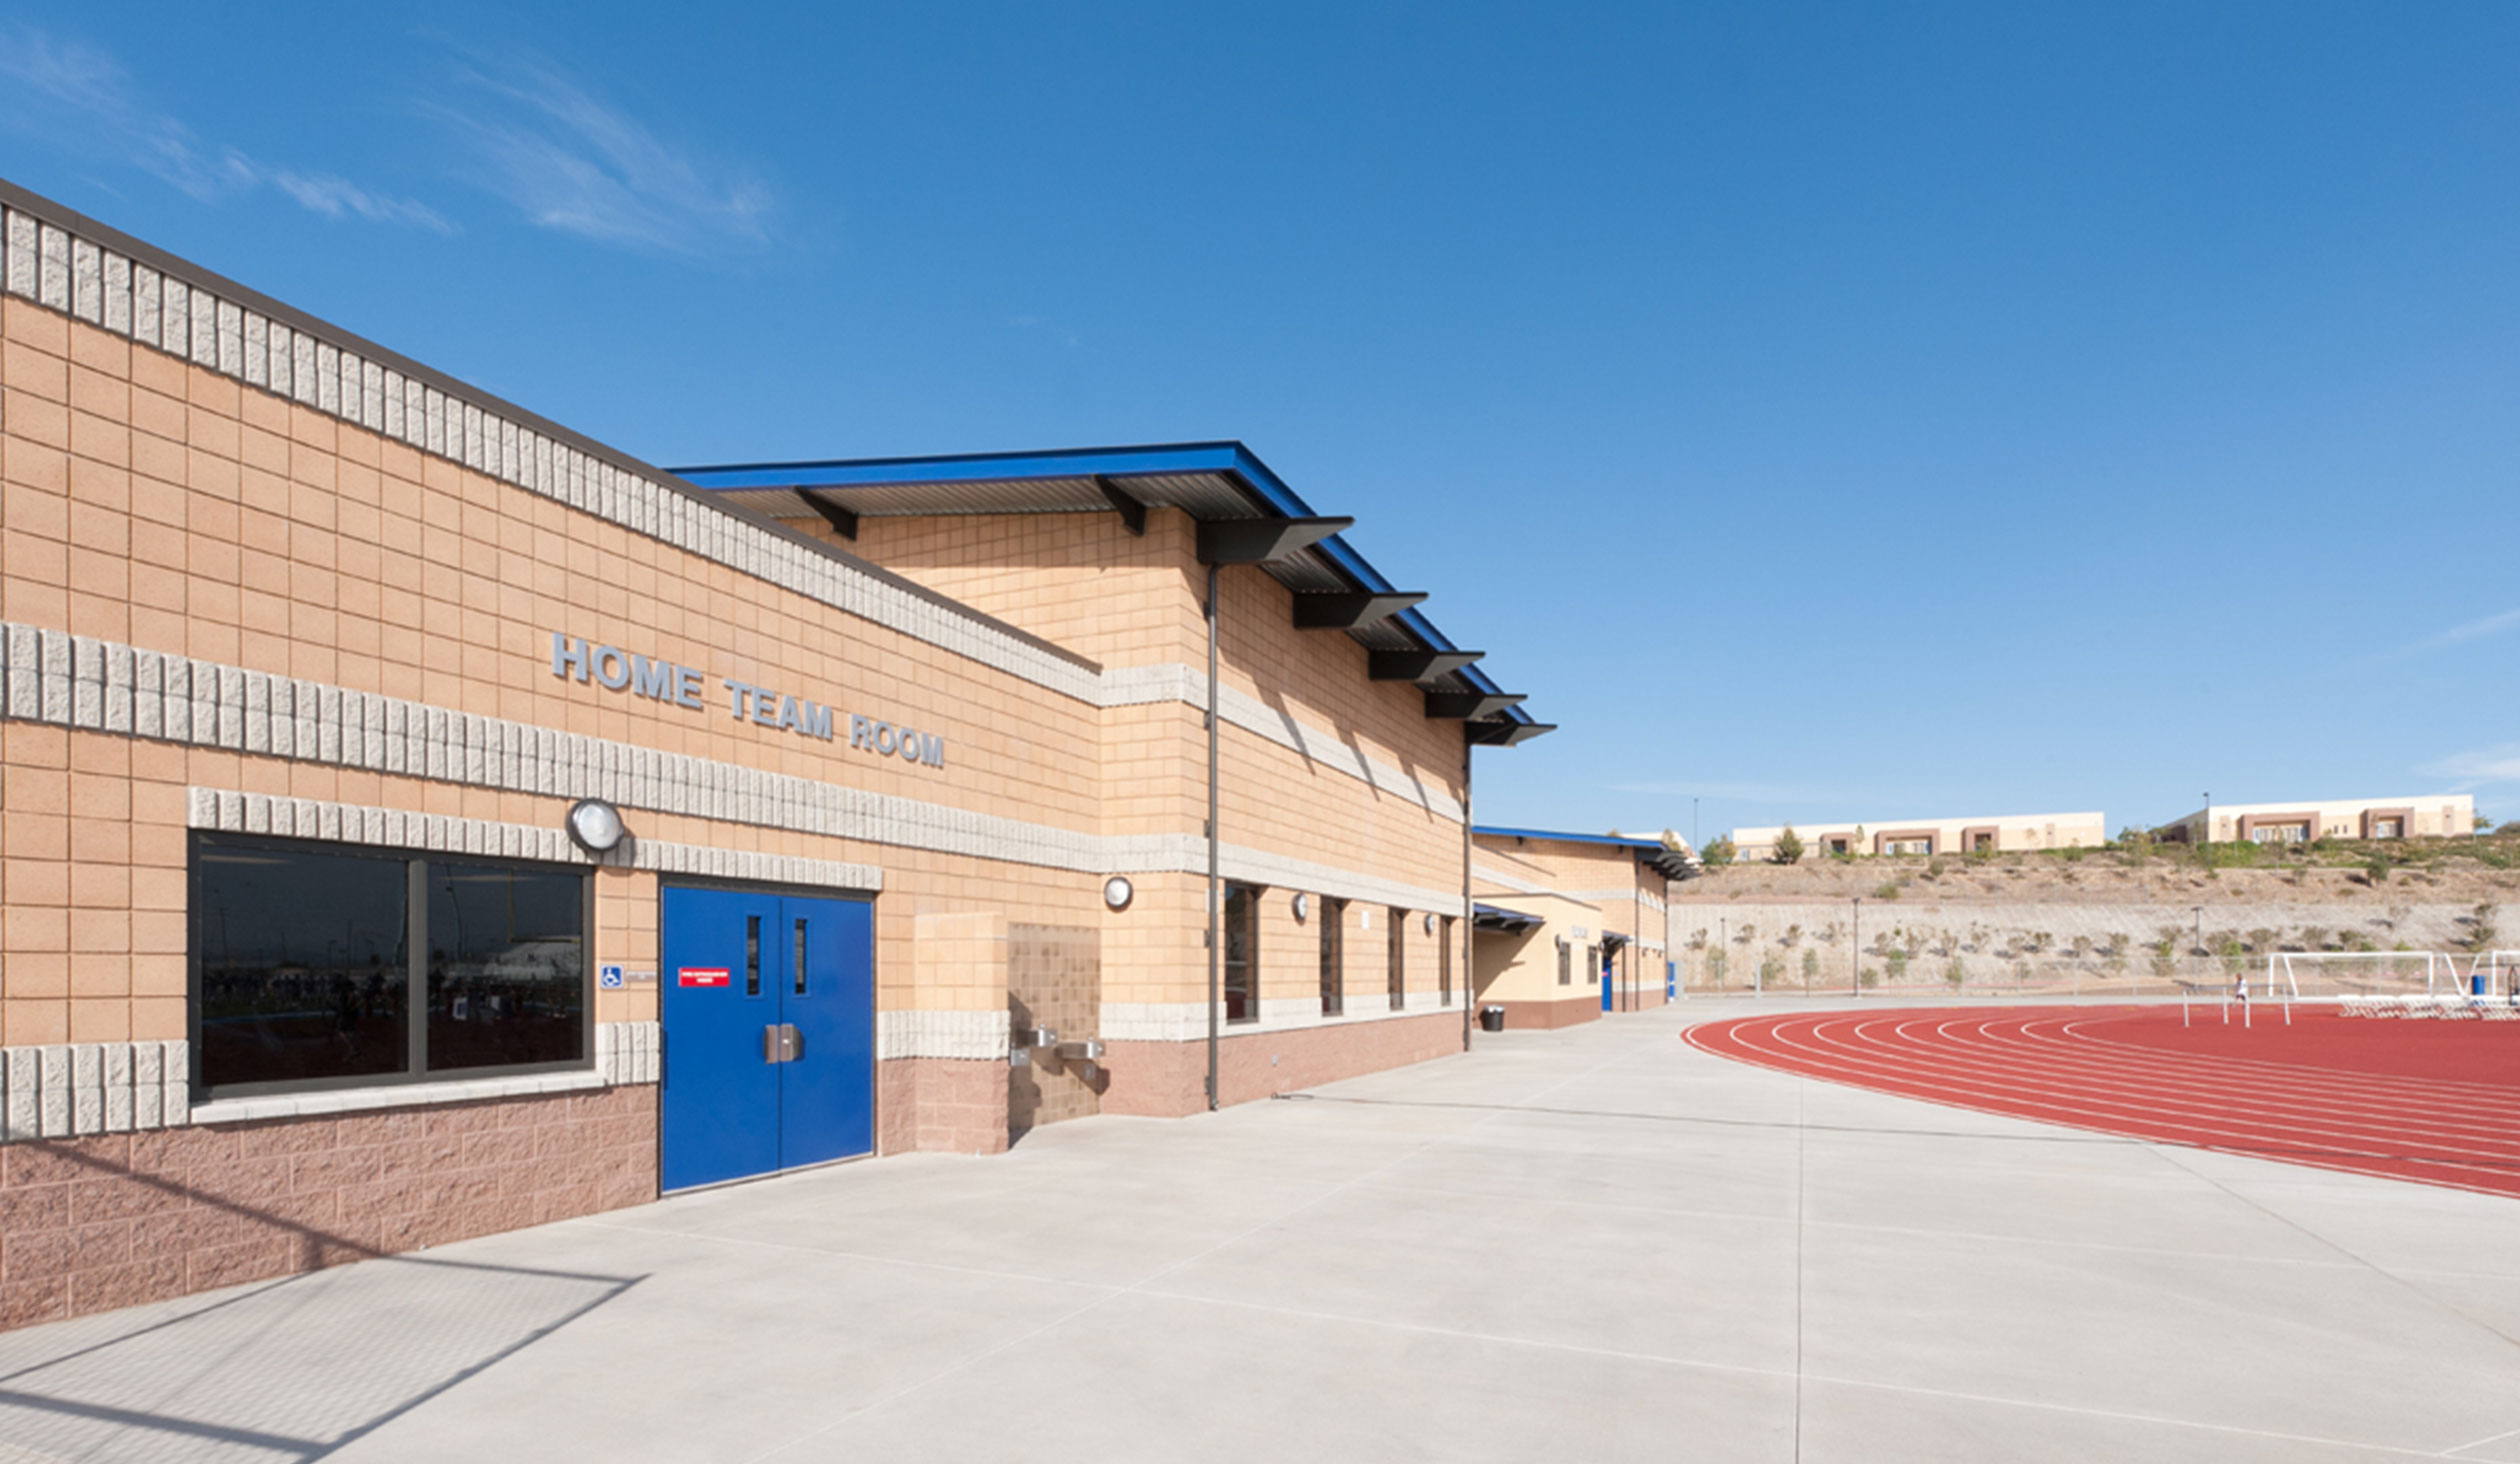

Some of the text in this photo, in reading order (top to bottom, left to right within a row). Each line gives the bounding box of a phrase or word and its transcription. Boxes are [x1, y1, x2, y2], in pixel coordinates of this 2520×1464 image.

[551, 632, 944, 767] HOME TEAM ROOM
